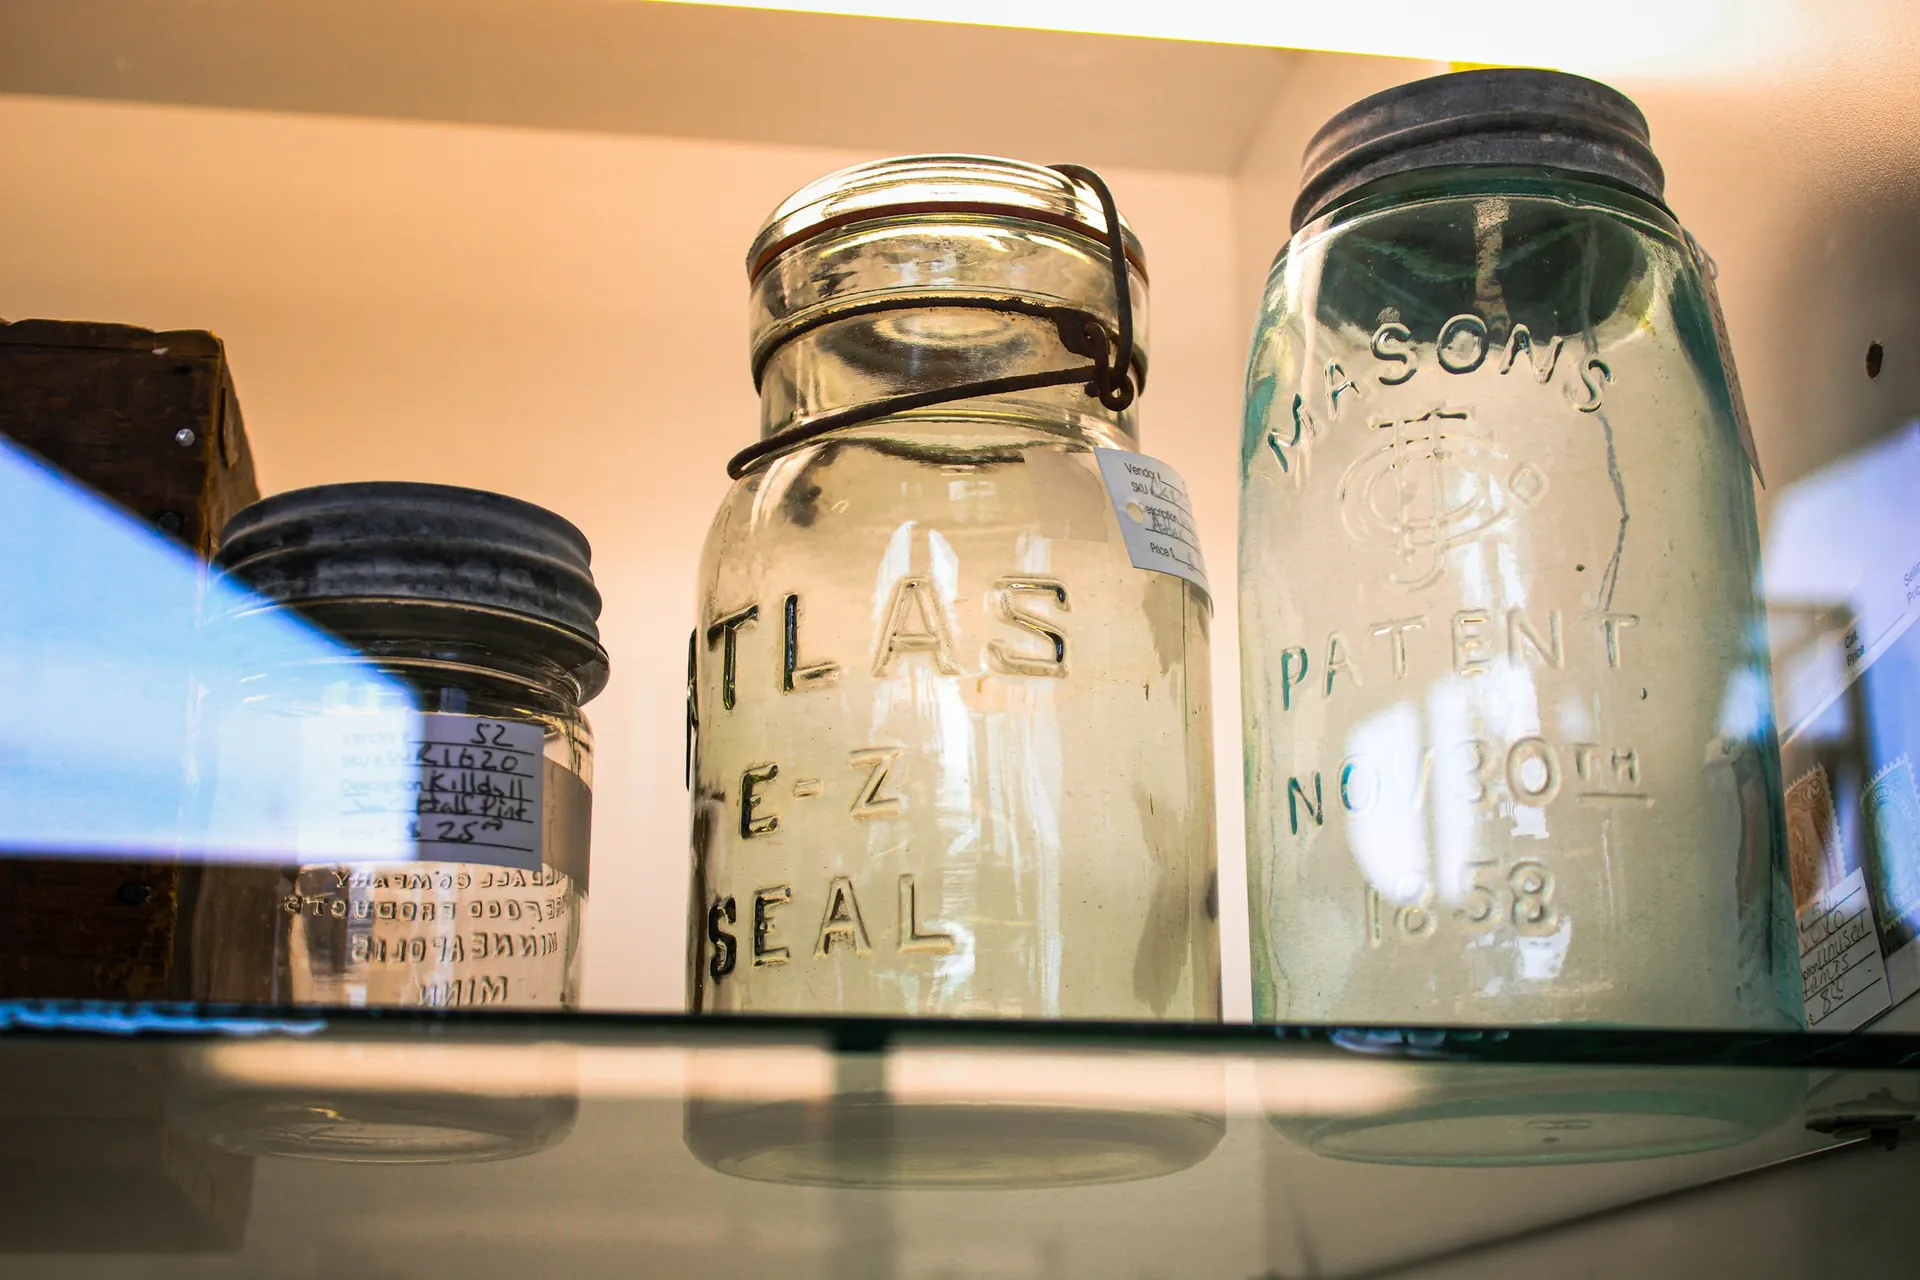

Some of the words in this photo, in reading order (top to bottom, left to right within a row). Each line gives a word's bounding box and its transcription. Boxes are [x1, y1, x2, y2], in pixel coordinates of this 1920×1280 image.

[1131, 481, 1148, 495] SKU
[1138, 503, 1178, 524] escription
[1149, 542, 1170, 556] Price
[1280, 608, 1641, 711] PATENT
[1847, 644, 1865, 667] Price
[470, 723, 514, 747] 52
[708, 873, 956, 983] SEAL
